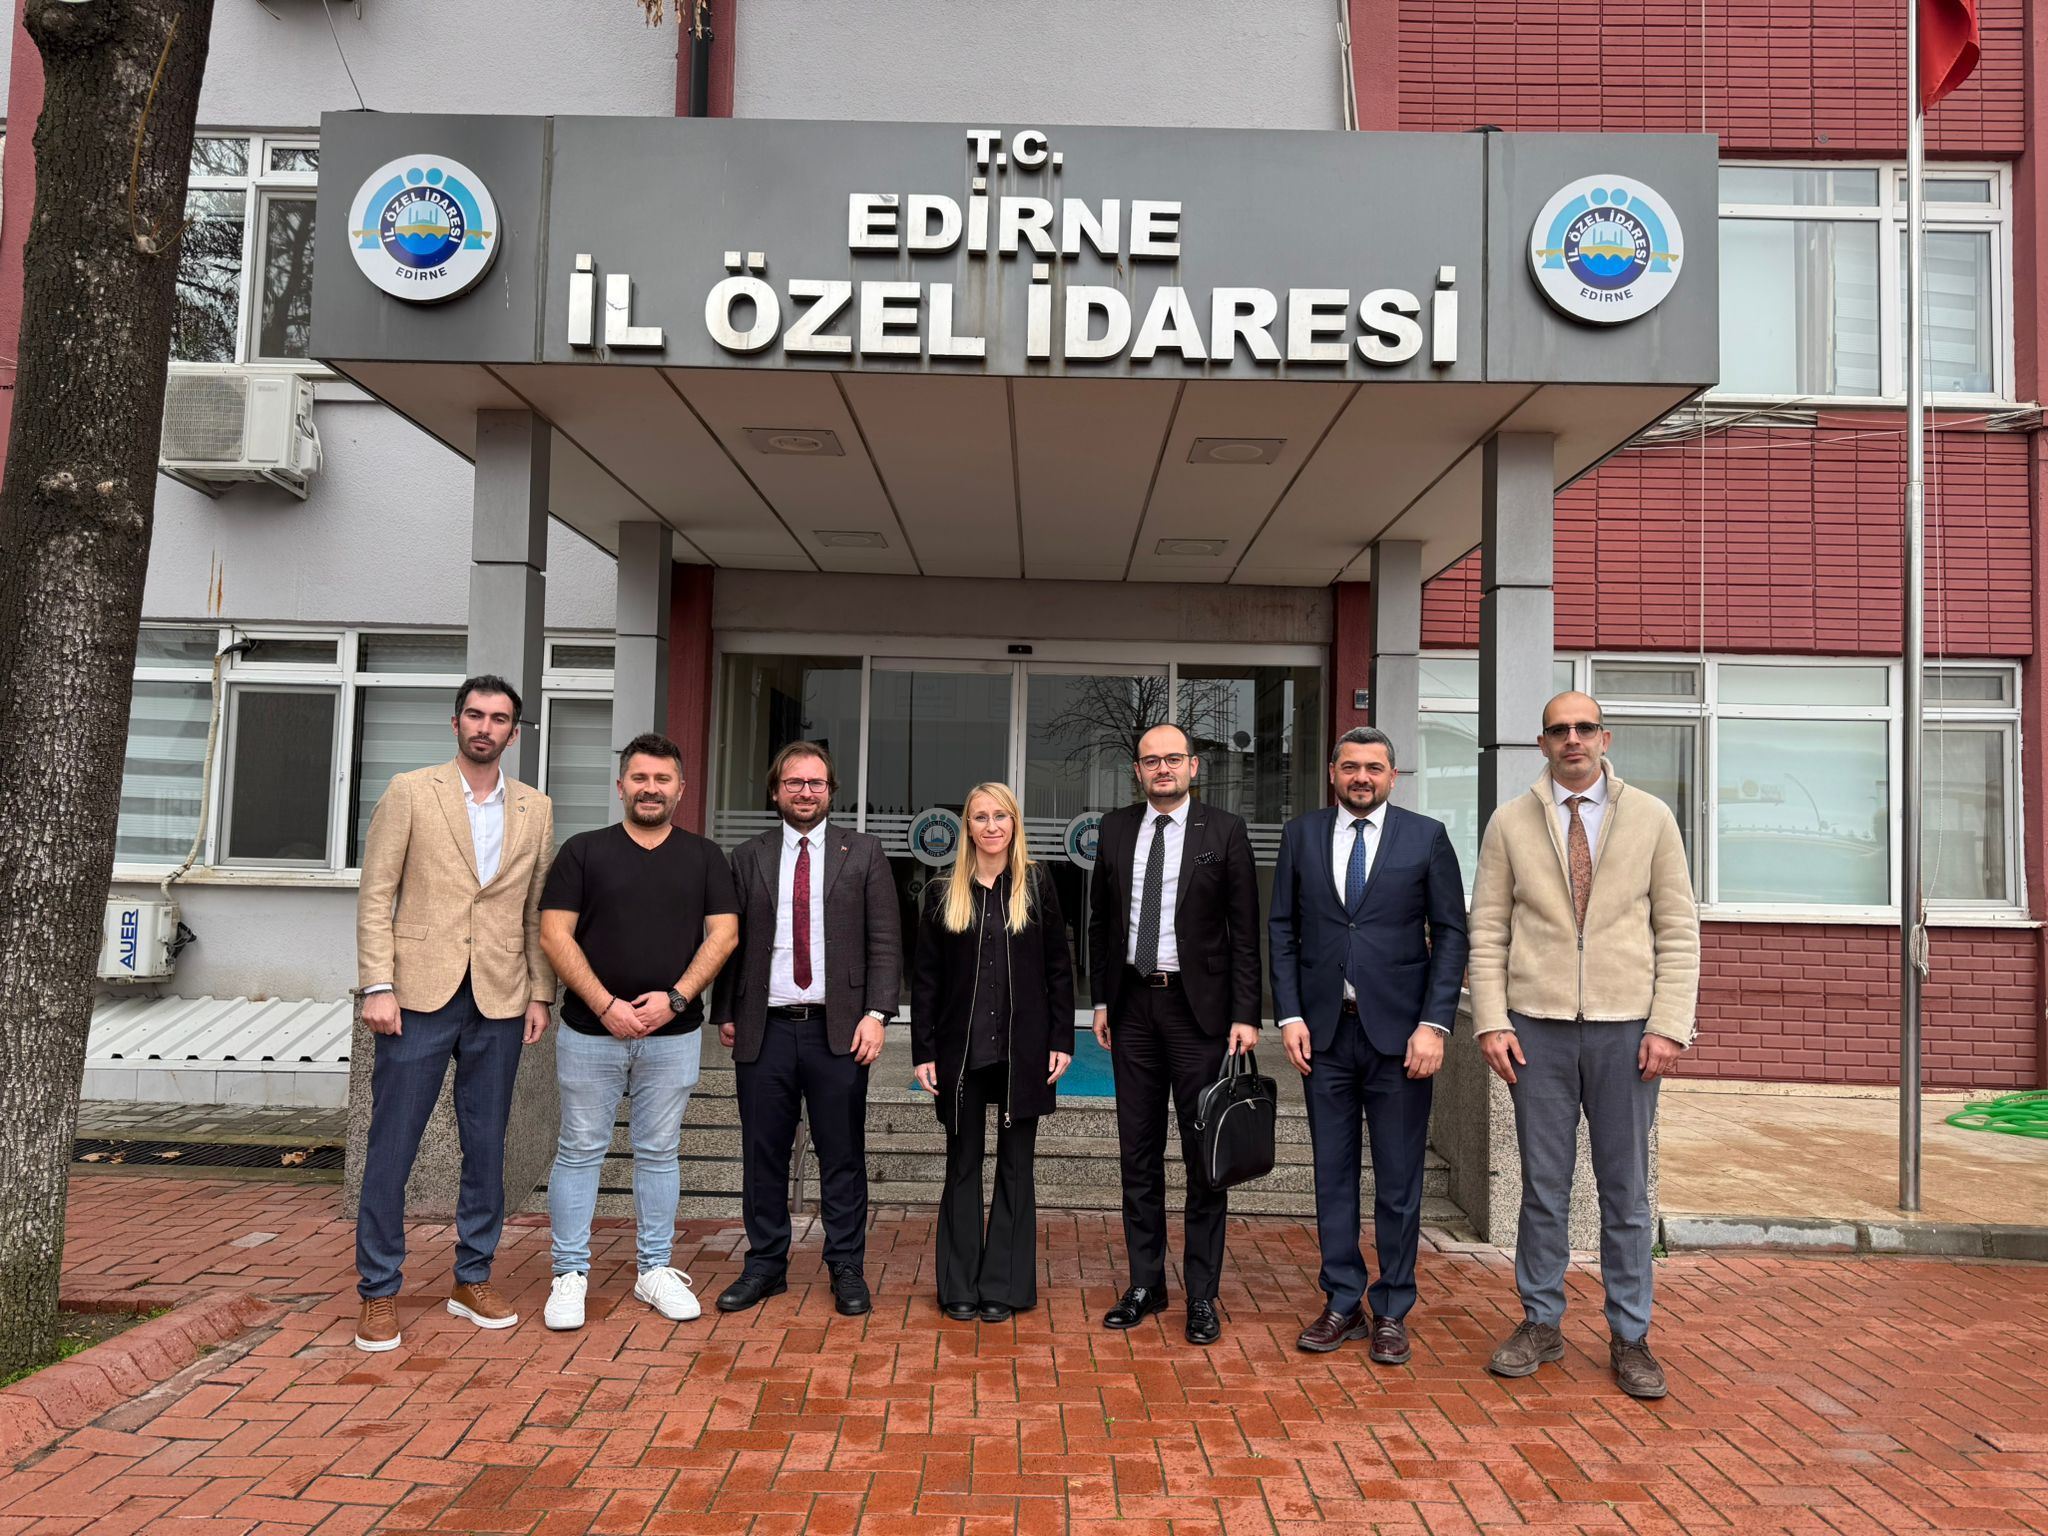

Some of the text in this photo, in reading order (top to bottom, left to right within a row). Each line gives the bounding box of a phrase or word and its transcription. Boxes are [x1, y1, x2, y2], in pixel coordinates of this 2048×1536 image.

[966, 129, 1064, 166] T.C.
[383, 188, 462, 245] İL ÖZEL İDARESİ
[849, 177, 1182, 256] EDİRNE
[1567, 209, 1647, 266] İL ÖZEL İDARESİ
[395, 266, 448, 281] EDİRNE
[1579, 287, 1634, 303] EDİRNE
[568, 251, 1458, 366] İL ÖZEL İDARESİ
[119, 909, 139, 971] AUER
